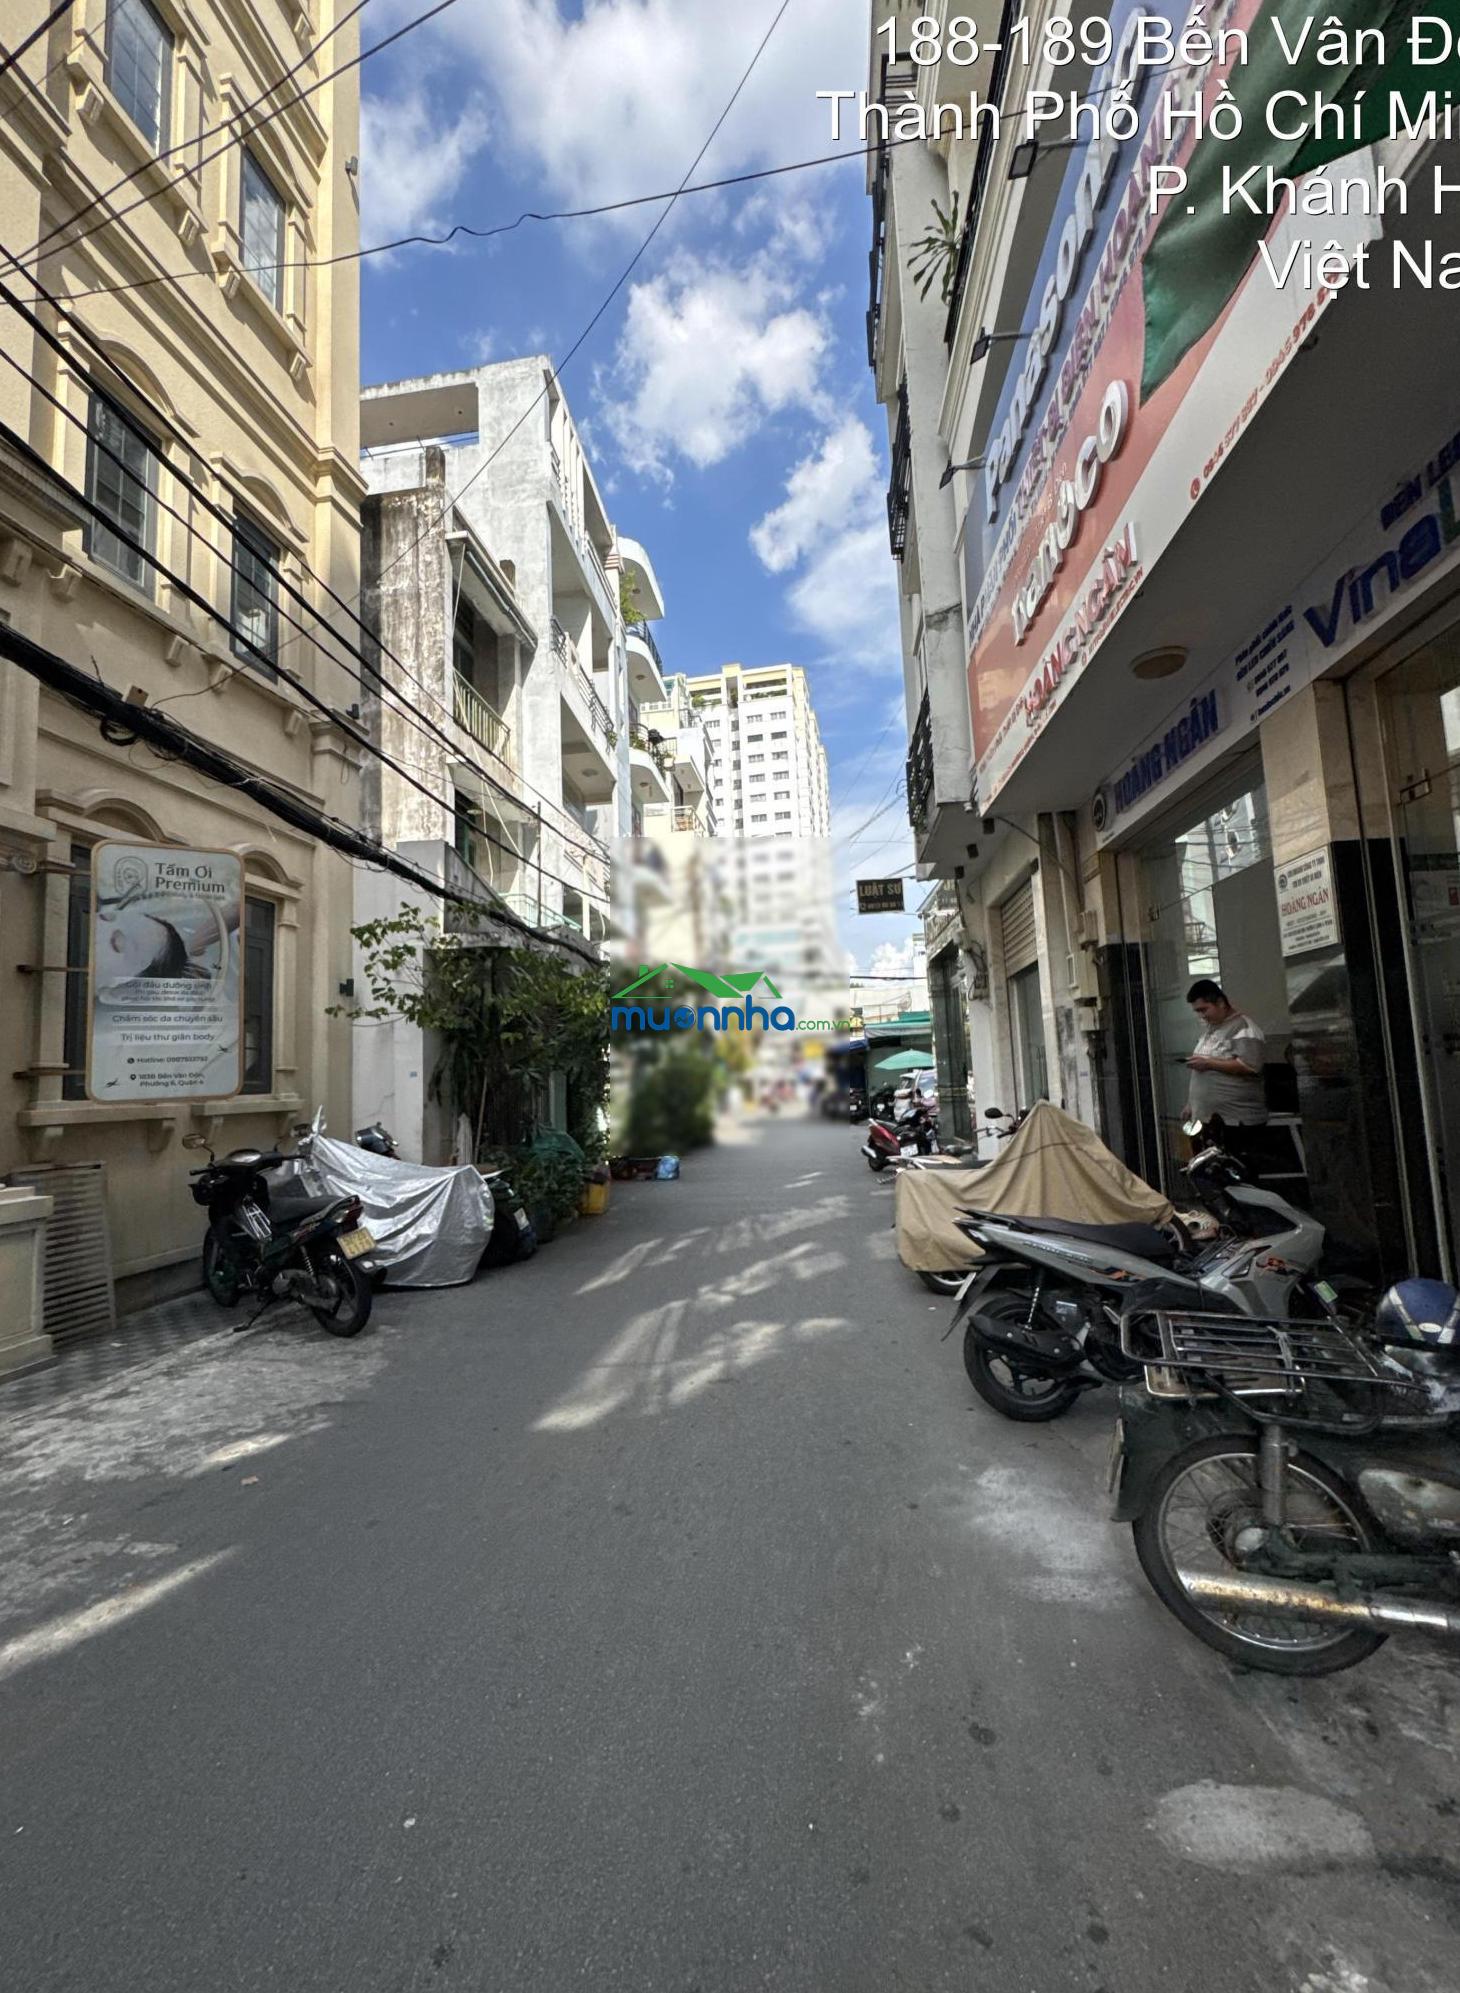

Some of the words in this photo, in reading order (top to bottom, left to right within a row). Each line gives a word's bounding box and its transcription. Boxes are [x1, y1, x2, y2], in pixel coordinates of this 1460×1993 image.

[155, 876, 226, 893] Premium
[860, 882, 885, 898] LUẬT
[160, 1014, 171, 1023] da
[193, 1032, 215, 1042] body
